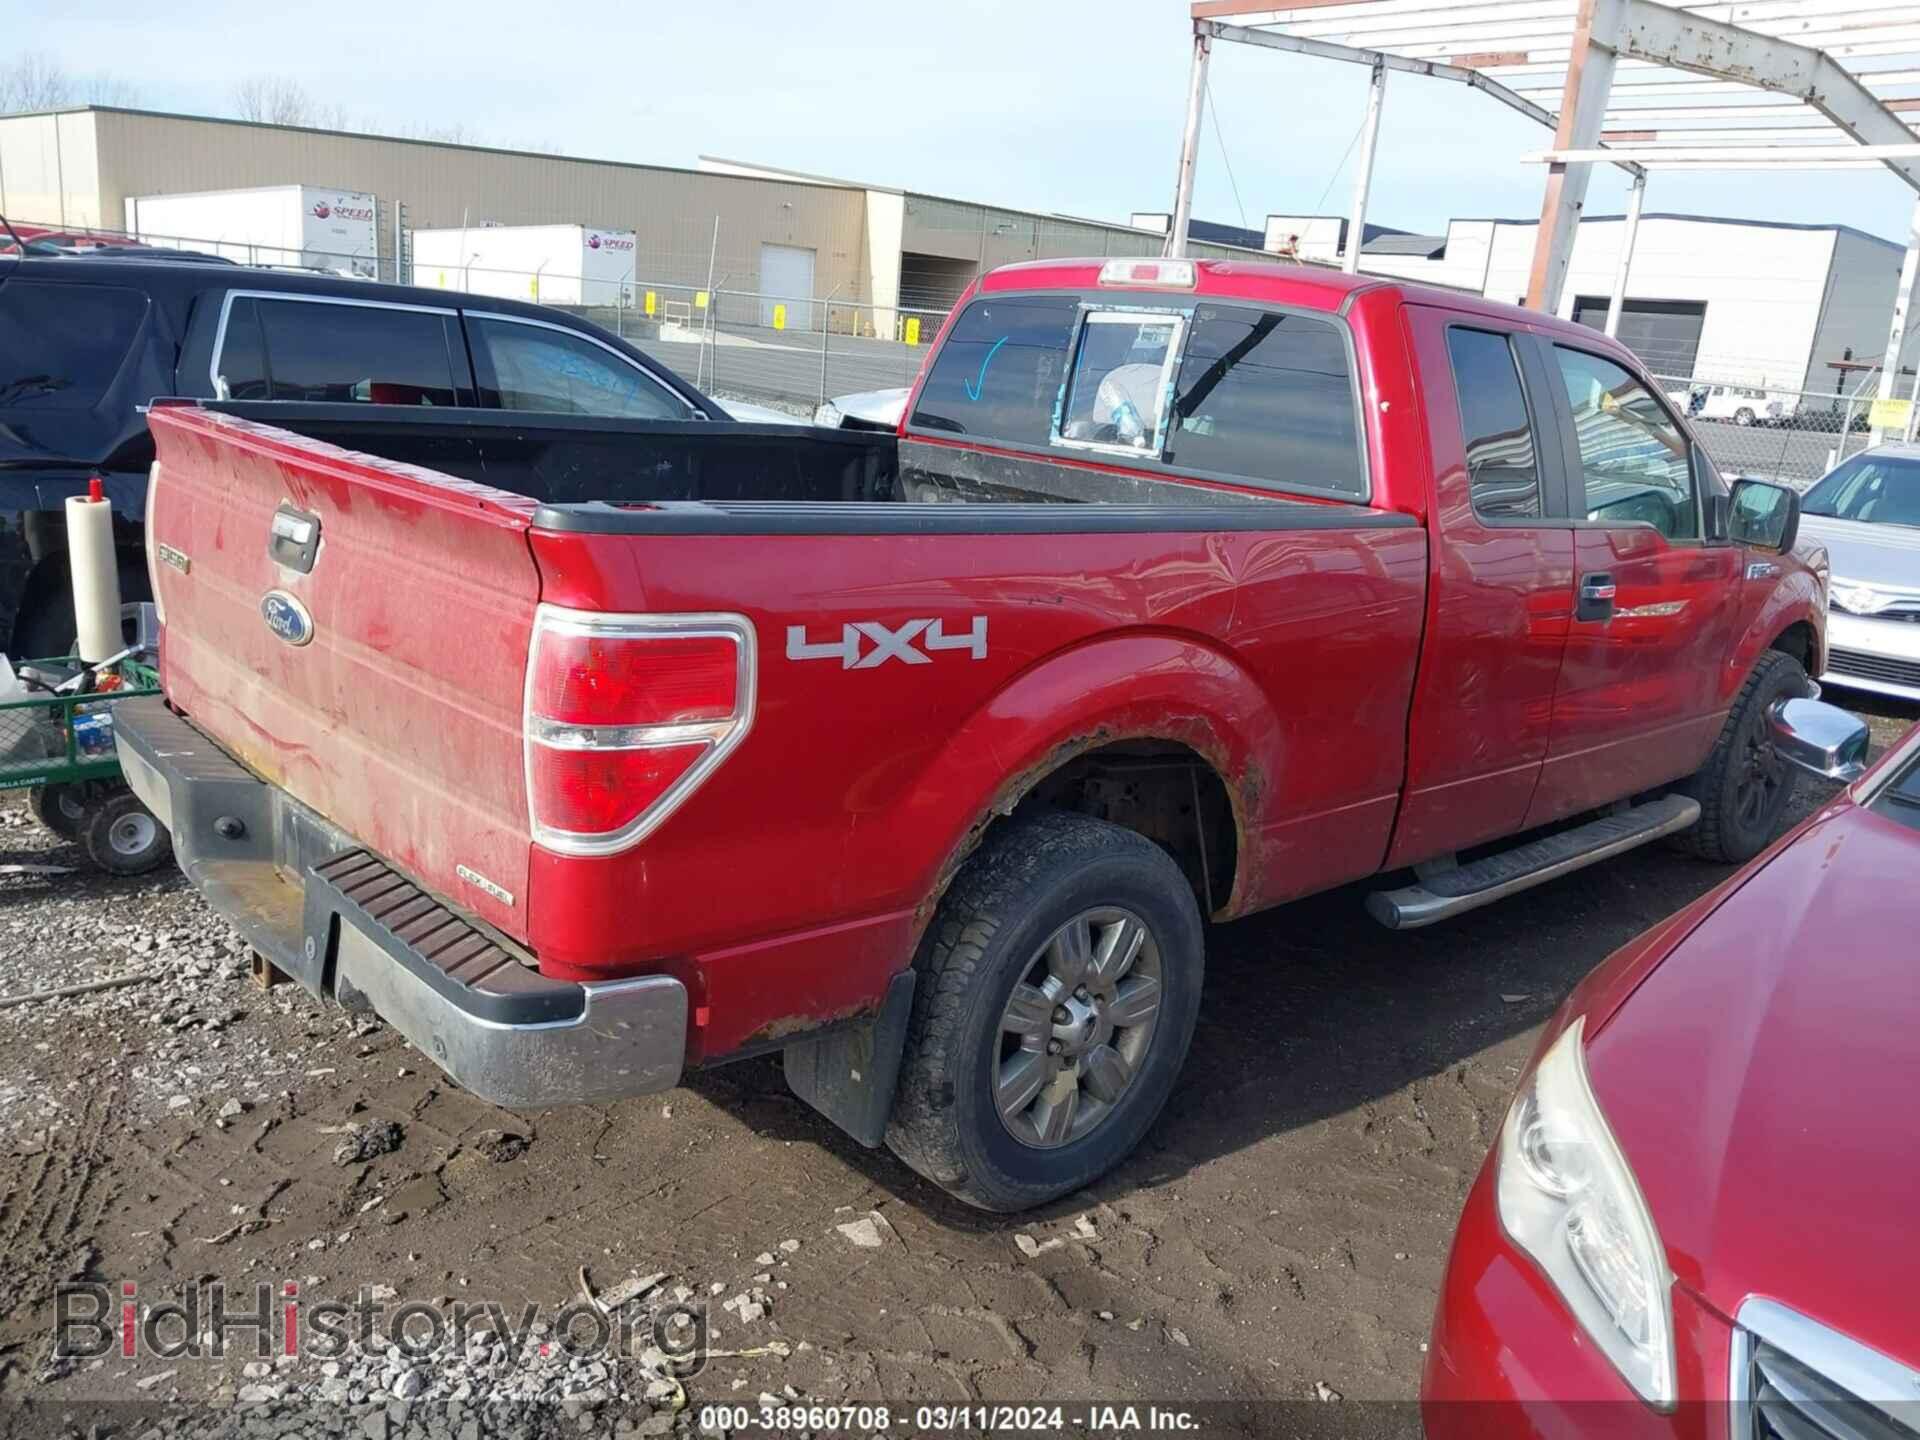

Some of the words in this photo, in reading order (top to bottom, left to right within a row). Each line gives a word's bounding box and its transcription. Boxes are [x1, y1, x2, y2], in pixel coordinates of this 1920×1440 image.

[333, 206, 374, 218] SPEED
[603, 239, 634, 249] SPEED
[265, 598, 294, 636] Ford
[785, 615, 988, 670] 4X4
[458, 866, 482, 885] FLEX
[487, 883, 511, 904] FUEL
